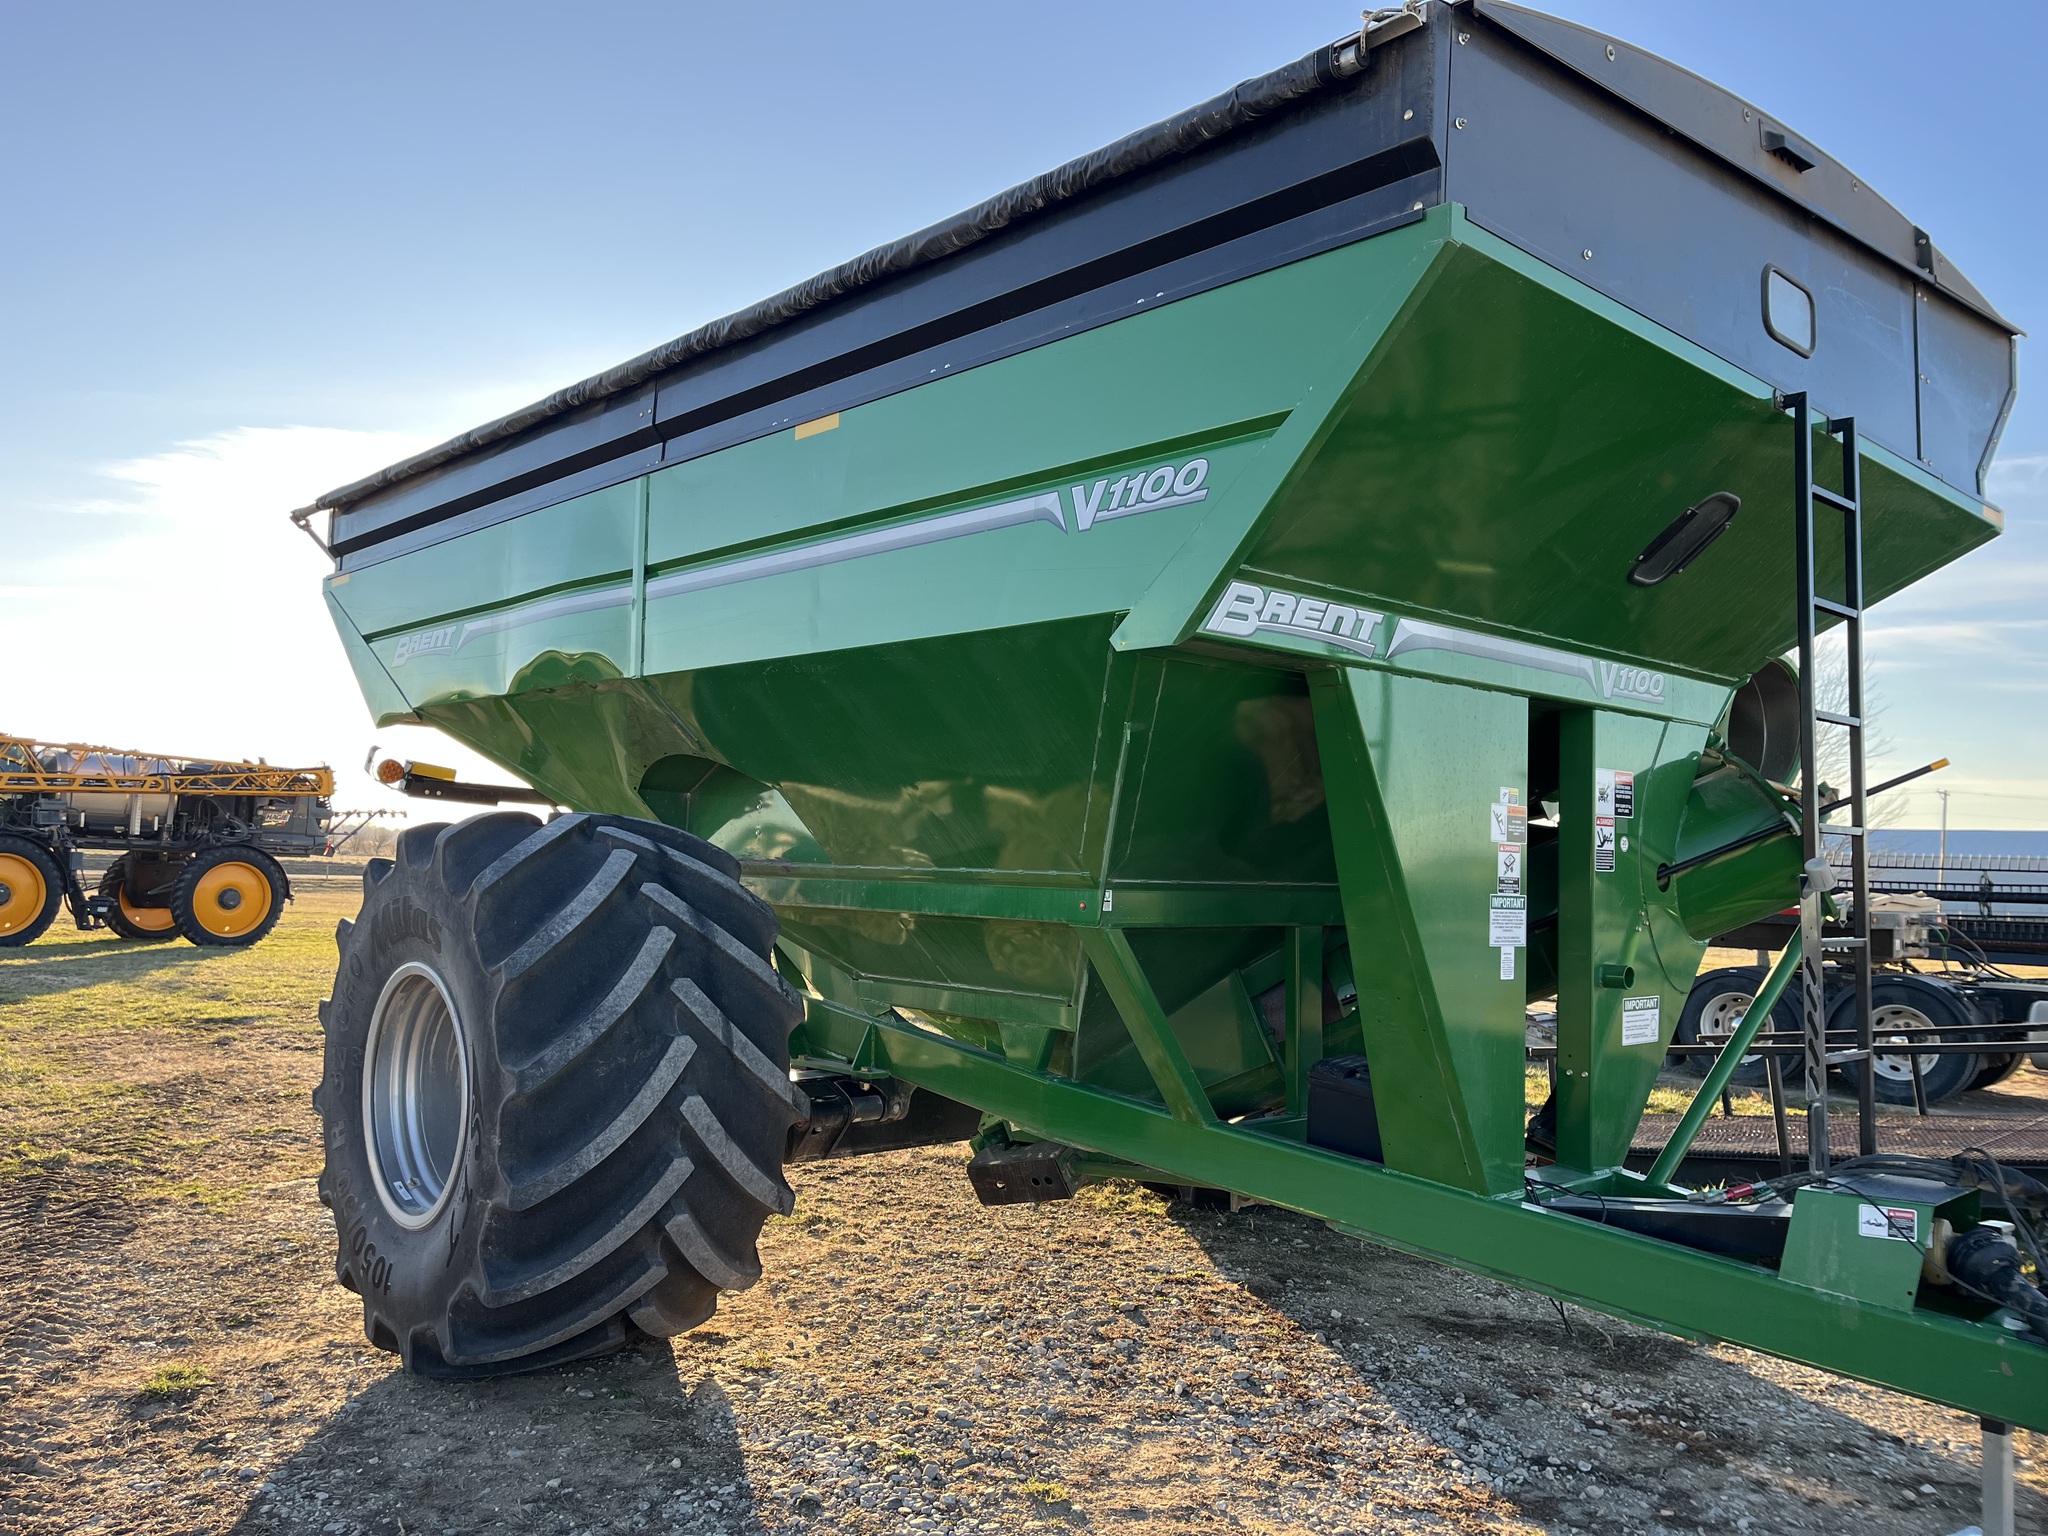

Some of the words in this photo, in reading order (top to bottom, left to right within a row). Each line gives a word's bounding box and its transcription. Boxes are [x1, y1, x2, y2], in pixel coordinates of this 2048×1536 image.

[1071, 458, 1210, 532] V1100
[1204, 579, 1386, 660] BRENT
[391, 625, 458, 669] BRENT
[1600, 661, 1666, 706] V1100
[1492, 896, 1525, 908] IMPORTANT
[1624, 998, 1658, 1010] IMPORTANT
